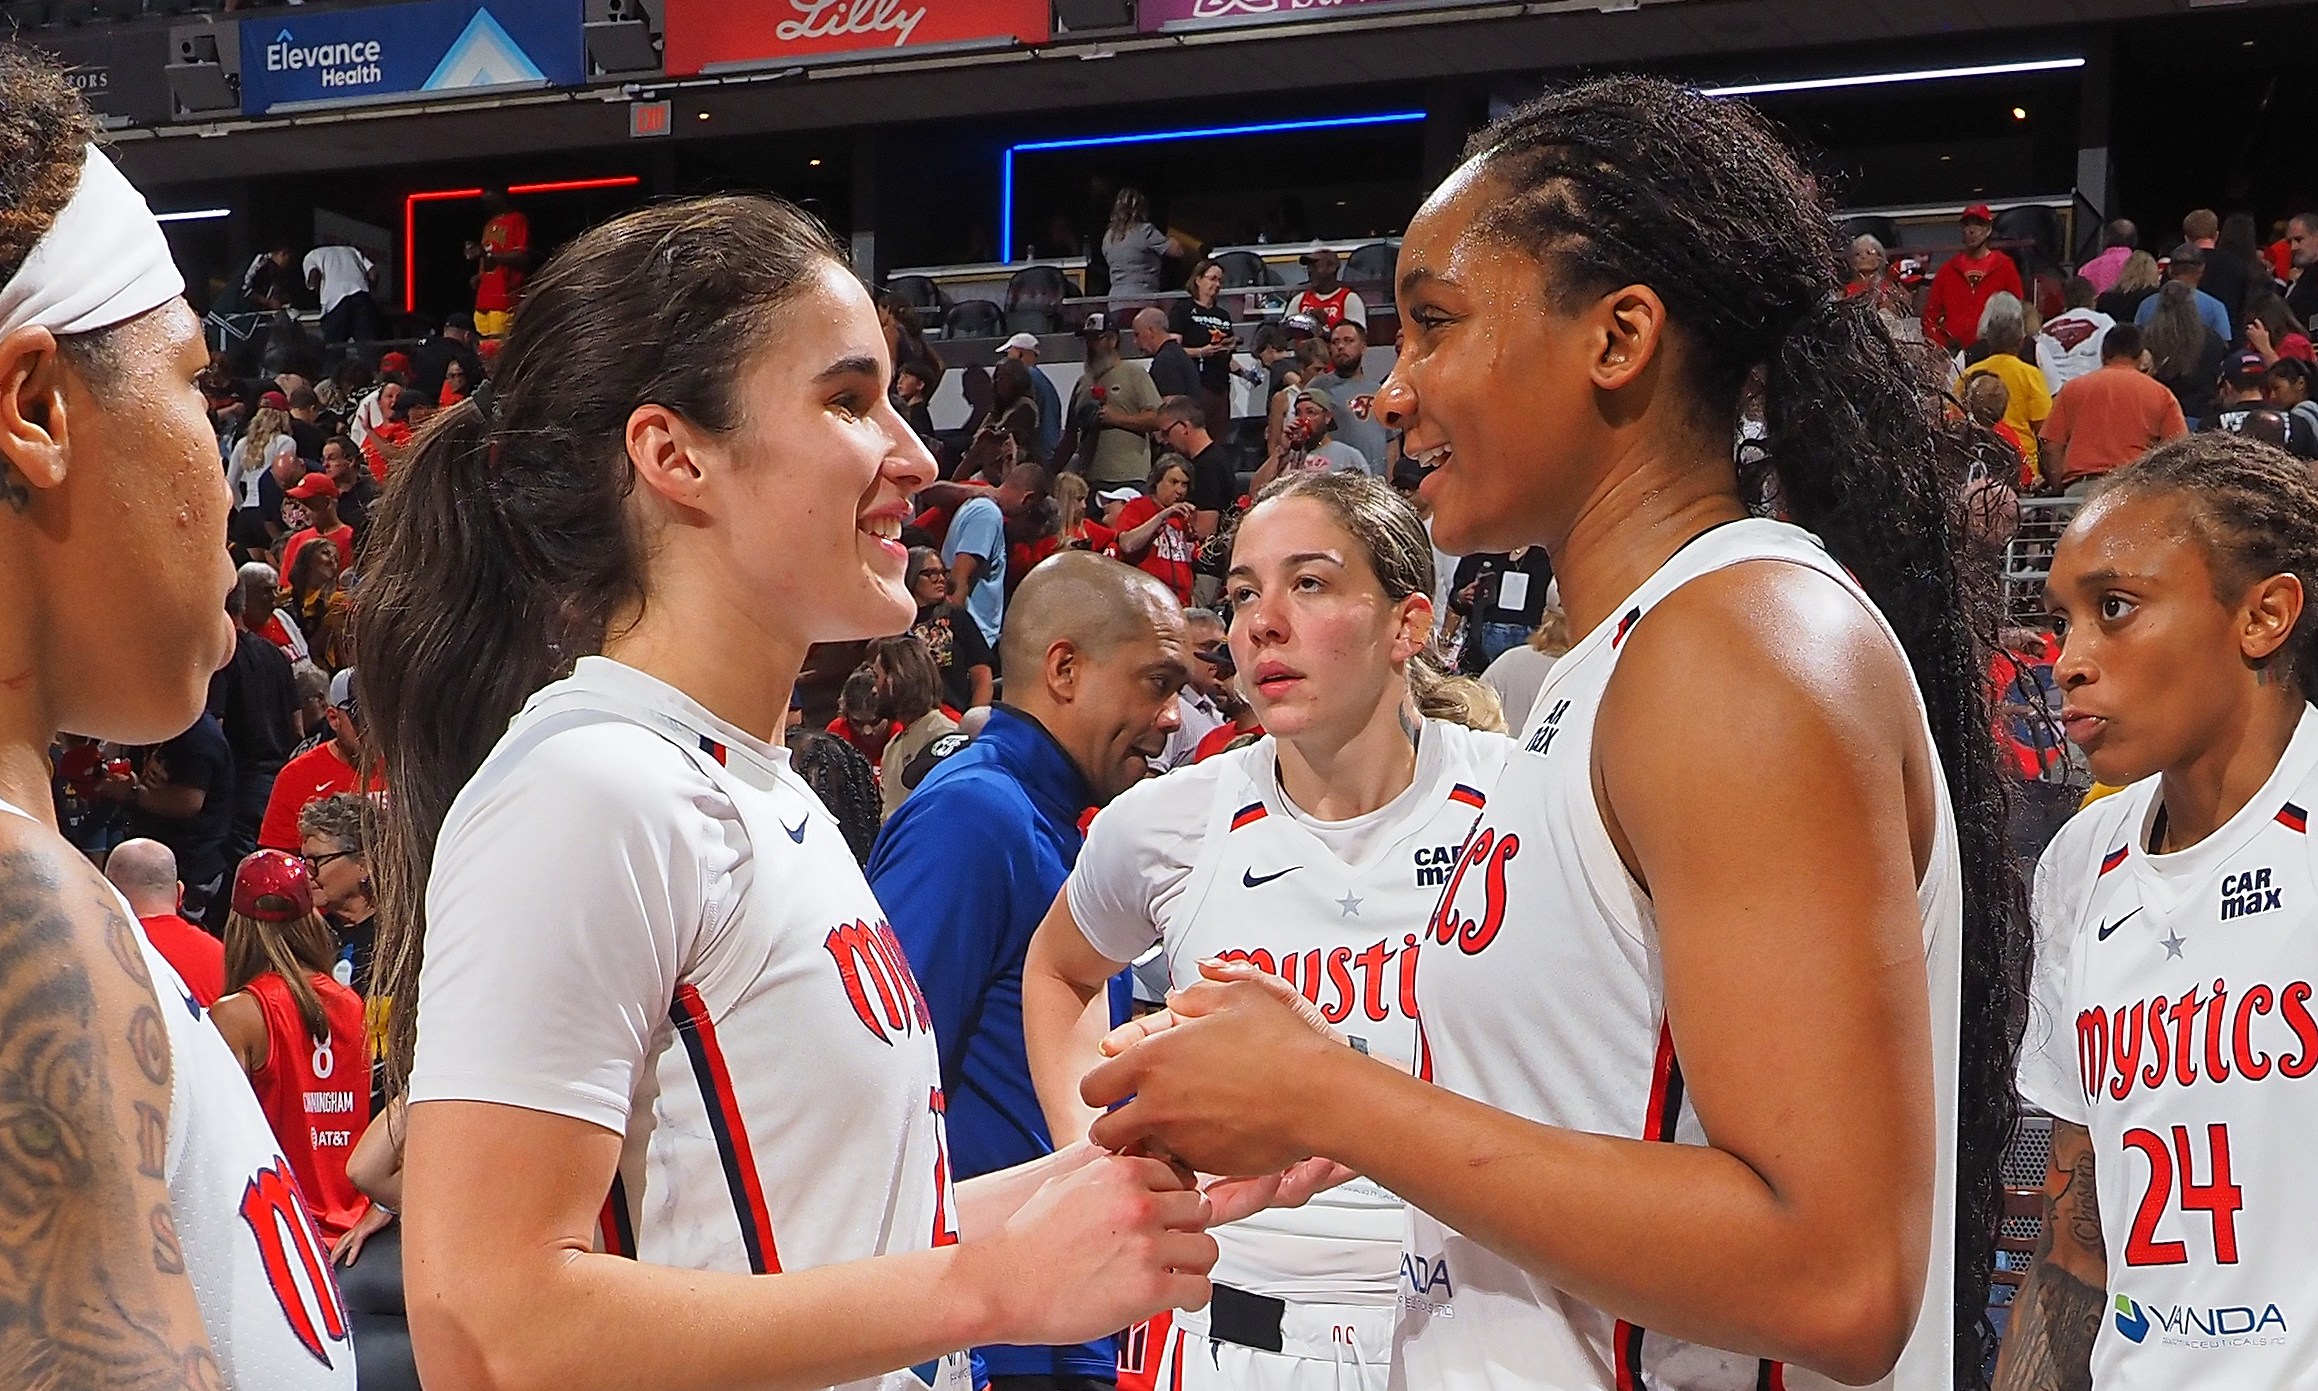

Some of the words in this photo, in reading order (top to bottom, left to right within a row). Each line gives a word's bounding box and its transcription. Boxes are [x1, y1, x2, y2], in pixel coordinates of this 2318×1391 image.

[776, 0, 927, 47] Lilly
[267, 41, 381, 71] Elevance
[322, 63, 381, 87] Health
[2221, 868, 2272, 897] CAR
[2221, 888, 2282, 921] max
[318, 1130, 352, 1147] AT&T
[2122, 1122, 2243, 1267] 24
[2148, 1303, 2288, 1336] VANDA
